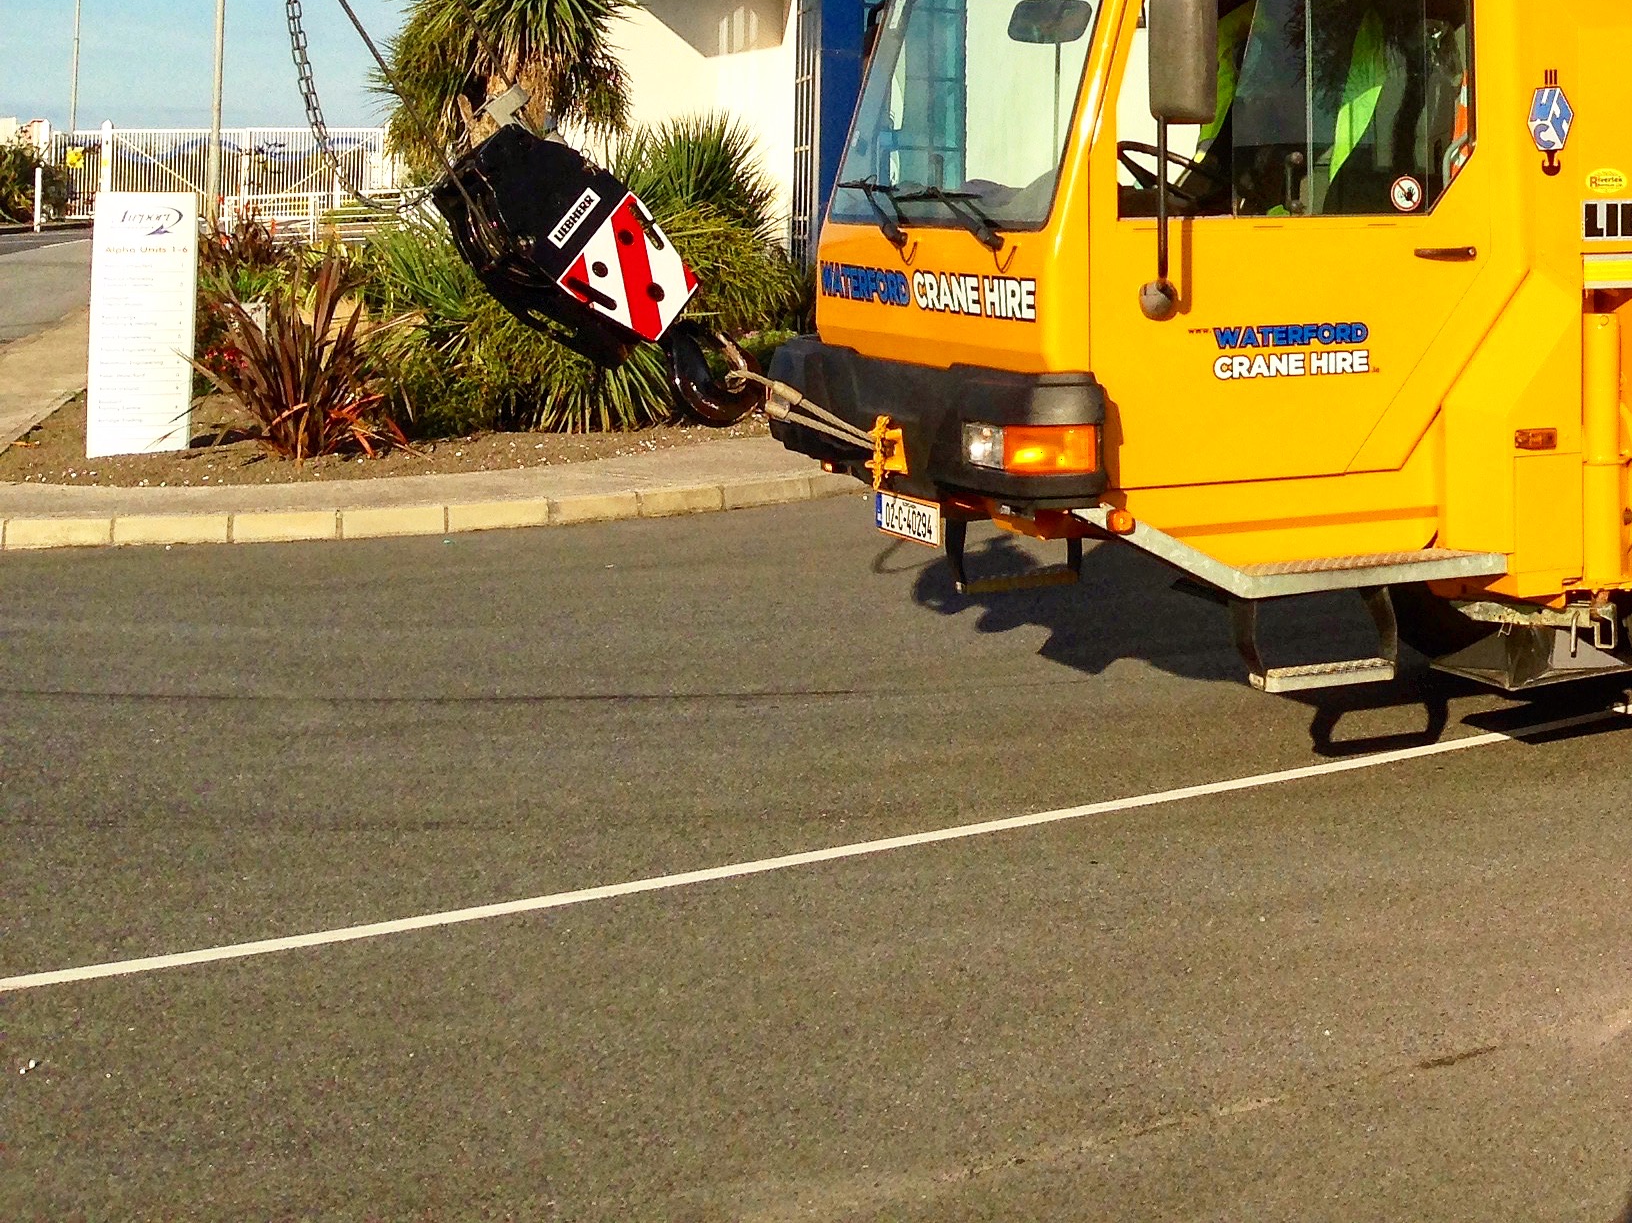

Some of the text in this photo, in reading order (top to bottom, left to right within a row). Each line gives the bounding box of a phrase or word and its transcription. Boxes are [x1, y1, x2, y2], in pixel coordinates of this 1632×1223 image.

[554, 194, 595, 243] LIEBHERR
[105, 246, 136, 255] Alpha
[140, 246, 167, 254] Units
[820, 260, 1037, 323] WATERFORD CRANE HIRE
[1213, 322, 1369, 350] WATERFORD
[1213, 353, 1306, 381] CRANE
[1310, 349, 1370, 376] HIRE
[885, 502, 932, 540] 02-C-40294
